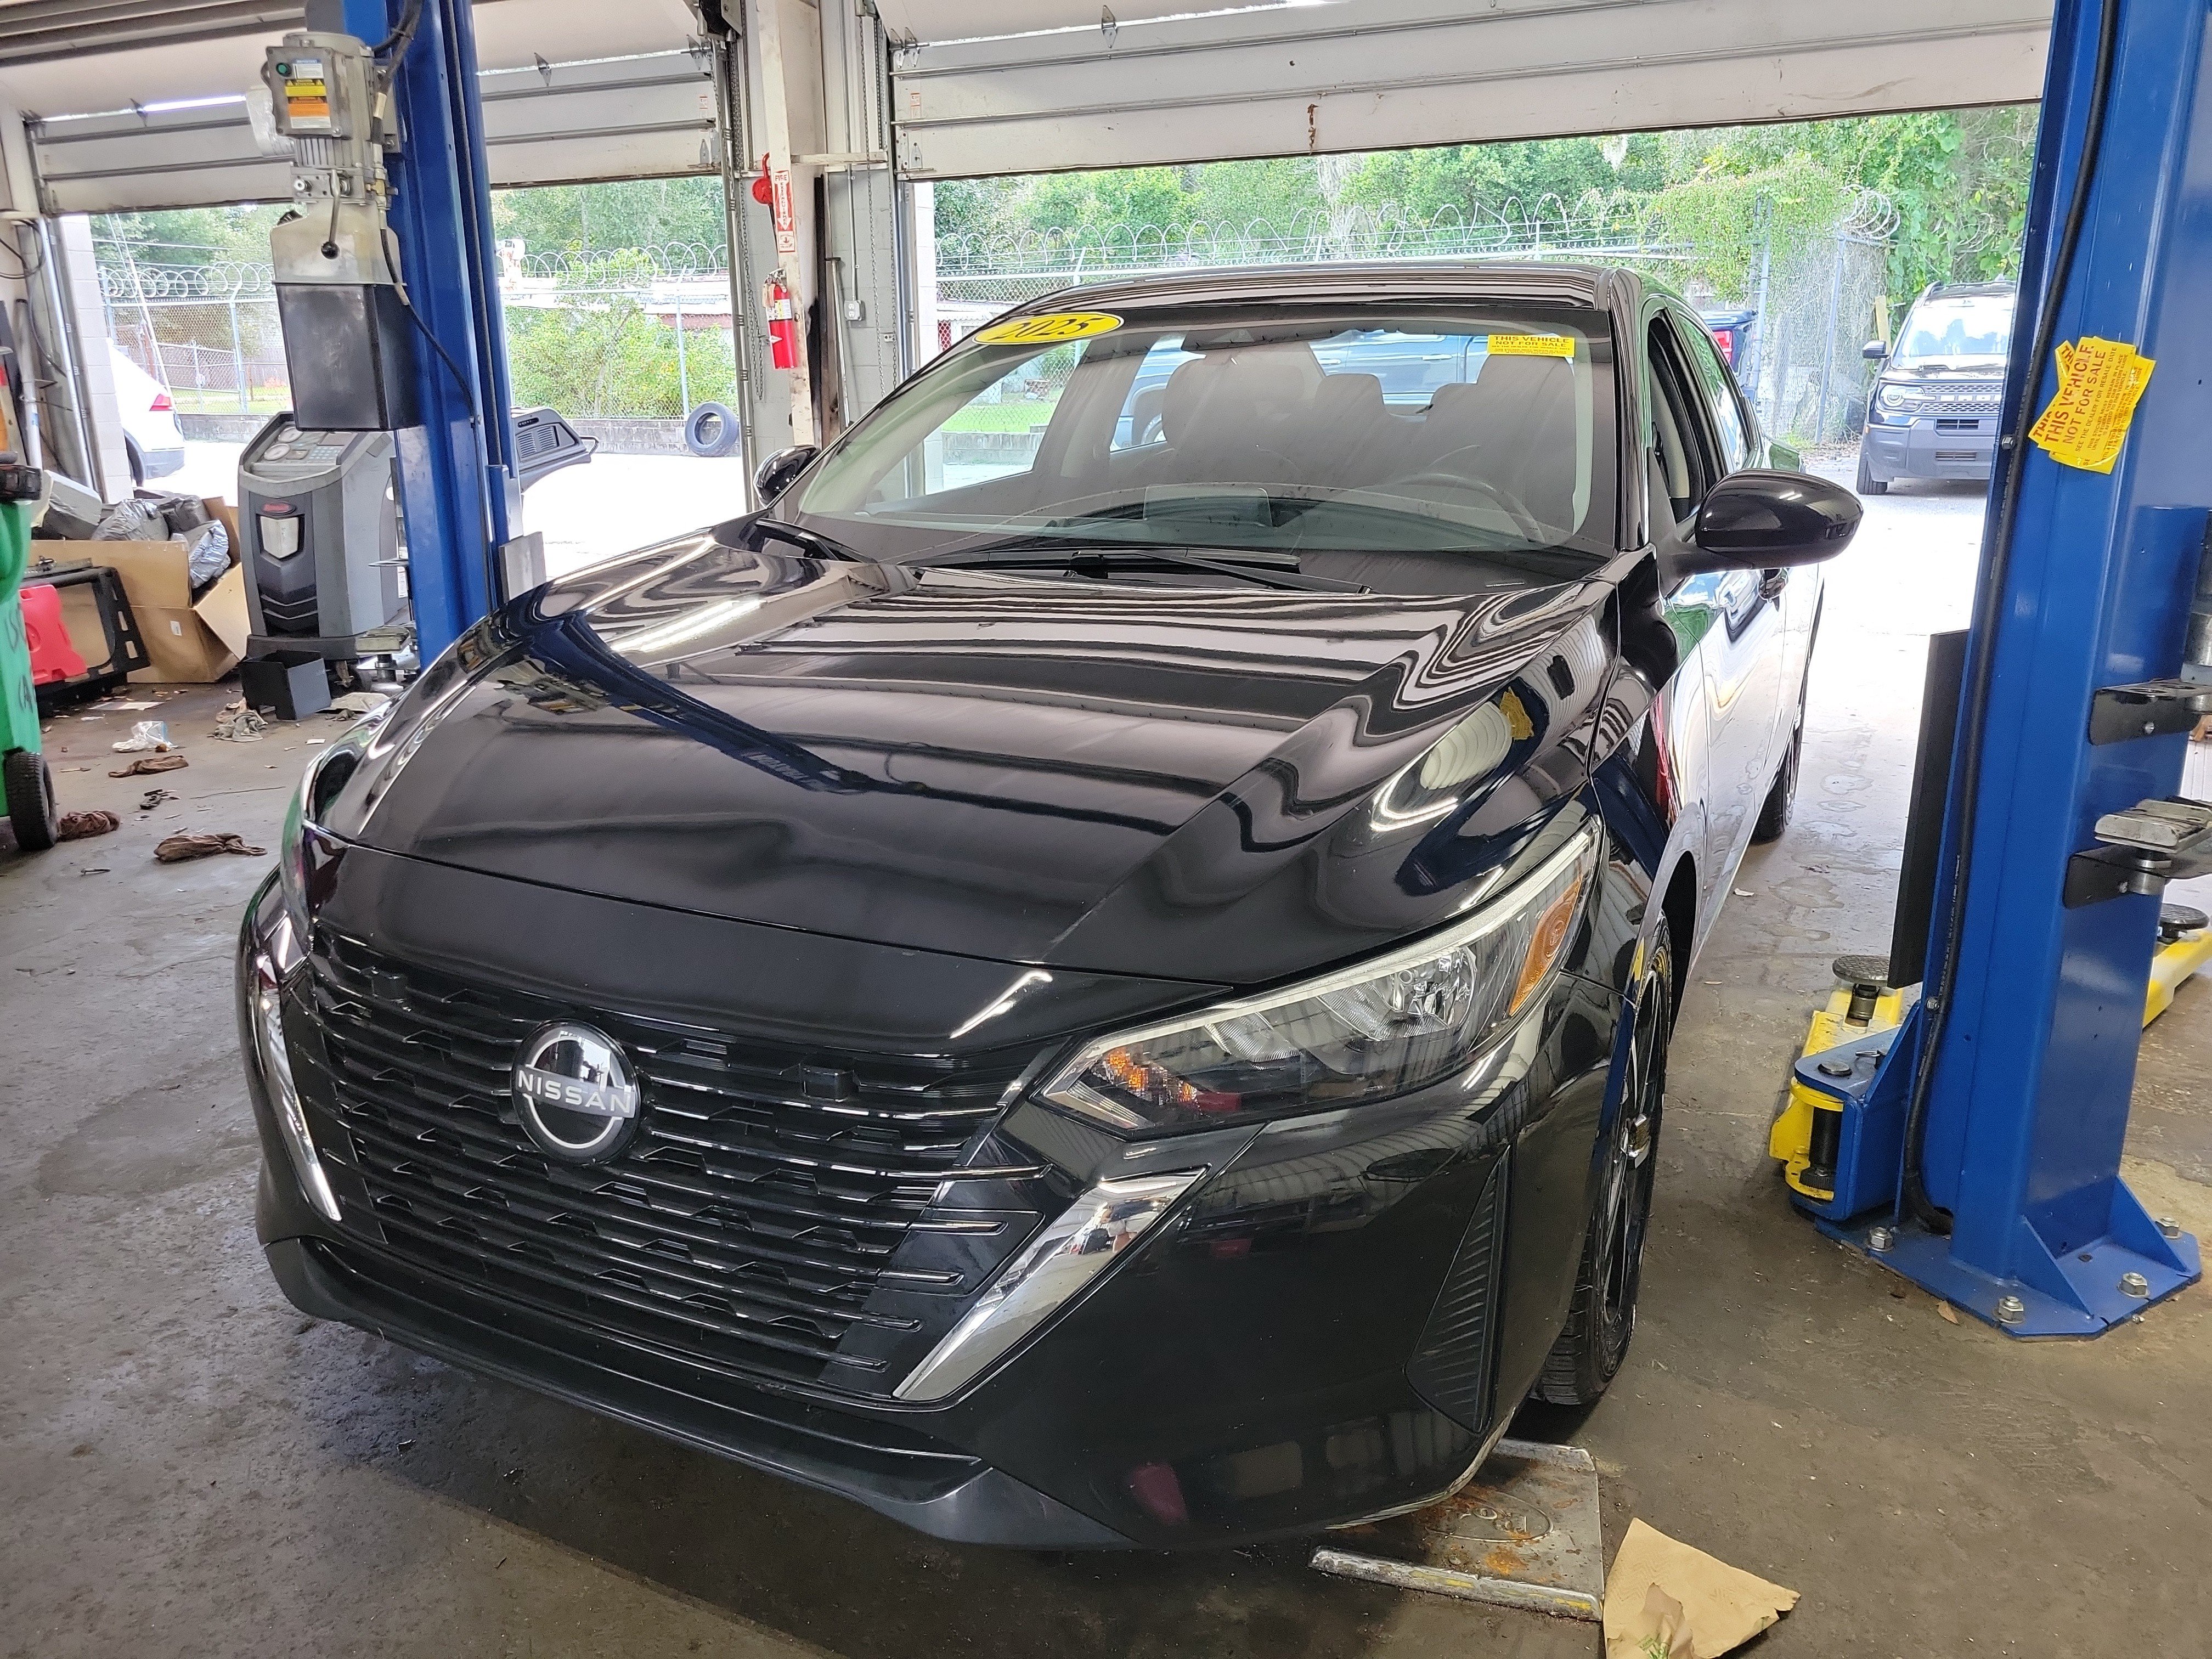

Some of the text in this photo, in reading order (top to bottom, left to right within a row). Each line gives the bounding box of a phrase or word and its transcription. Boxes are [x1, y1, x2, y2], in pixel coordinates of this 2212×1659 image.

[988, 318, 1107, 341] 2025
[2044, 344, 2094, 442] THIS VEHICLE
[2062, 351, 2106, 444] NOT FOR SALE
[2075, 347, 2117, 451] SEE THE DEALER FOR RESALE DATE
[2100, 400, 2108, 414] MUST
[2106, 379, 2115, 398] REMAIN
[2114, 354, 2123, 370] PLACE
[2091, 438, 2100, 450] UNTIL
[517, 1069, 631, 1113] NISSAN
